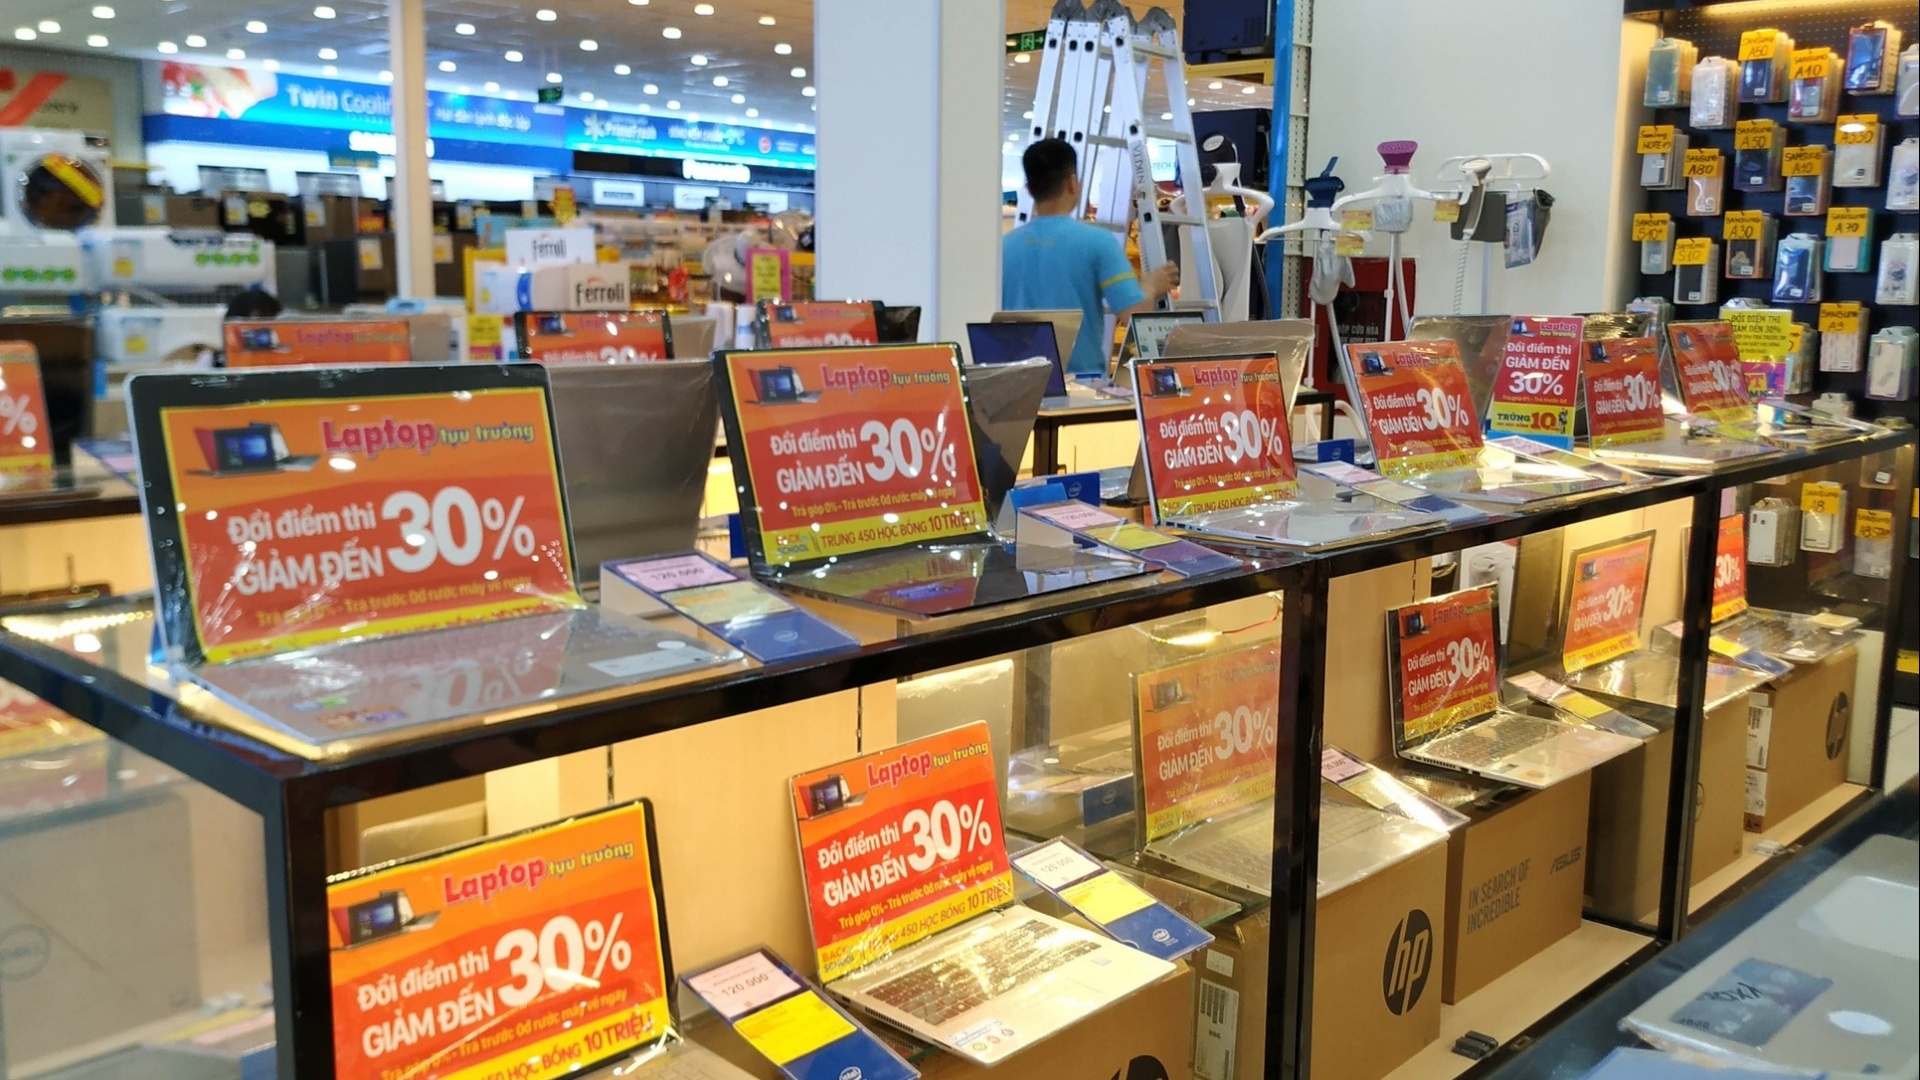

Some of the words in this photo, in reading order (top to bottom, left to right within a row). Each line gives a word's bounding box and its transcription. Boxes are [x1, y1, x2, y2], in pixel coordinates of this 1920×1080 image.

[1749, 45, 1768, 57] A50
[1795, 65, 1822, 79] A10
[287, 84, 338, 110] Twin
[1685, 154, 1718, 162] SAMSUNG
[1688, 164, 1714, 176] A80
[1785, 152, 1822, 162] SAMSUNG
[1635, 219, 1668, 227] SAMSUNG
[1726, 217, 1761, 225] SAMSUNG
[1728, 225, 1754, 239] A30
[532, 239, 567, 261] Ferroli
[1678, 250, 1701, 261] S10
[575, 284, 624, 305] Ferroli
[1540, 321, 1577, 332] Laptop
[1820, 309, 1860, 318] SAMSUNG
[1506, 354, 1540, 369] GIẢM
[1541, 355, 1570, 370] ĐẾN
[1507, 341, 1525, 352] Đổi
[1527, 342, 1554, 353] điểm
[1556, 344, 1571, 355] thi
[821, 363, 890, 392] Laptop
[1192, 365, 1239, 391] Laptop
[1509, 371, 1564, 395] 30%
[1373, 394, 1386, 410] Đổi
[1387, 392, 1406, 408] điểm
[1405, 393, 1417, 407] thi
[1624, 374, 1660, 412] 30%
[1379, 413, 1404, 435] GIẢM
[1403, 410, 1423, 432] ĐẾN
[1416, 387, 1469, 430] 30%
[1497, 411, 1530, 421] TRÚNG
[1530, 411, 1557, 430] 10
[320, 417, 438, 459] Laptop
[770, 429, 797, 456] Đổi
[799, 428, 836, 453] điểm
[838, 427, 857, 449] thi
[1159, 416, 1178, 439] Đổi
[1179, 414, 1203, 436] điểm
[1204, 415, 1219, 434] thi
[1220, 409, 1283, 460] 30%
[860, 417, 956, 482] 30%
[1164, 440, 1196, 470] GIẢM
[1196, 436, 1223, 466] ĐẾN
[776, 460, 825, 494] GIẢM
[825, 454, 865, 488] ĐẾN
[842, 498, 856, 510] Trả
[1217, 498, 1230, 510] 450
[227, 510, 271, 545] Đổi
[275, 505, 341, 540] điểm
[341, 502, 376, 531] thi
[382, 485, 536, 574] 30%
[821, 530, 855, 548] TRÚNG
[858, 529, 876, 543] 450
[876, 525, 899, 542] HỌC
[900, 519, 928, 536] BỔNG
[928, 517, 942, 532] 10
[234, 547, 317, 597] GIẢM
[319, 539, 384, 585] ĐẾN
[1715, 554, 1741, 588] 30%
[1433, 604, 1464, 623] Laptop
[1606, 584, 1636, 622] 30%
[1407, 653, 1419, 672] Đổi
[1419, 649, 1436, 667] điểm
[1436, 647, 1446, 662] thi
[1446, 637, 1490, 682] 30%
[1408, 672, 1429, 697] GIẢM
[1430, 666, 1448, 689] ĐẾN
[1157, 733, 1173, 751] Đổi
[1174, 723, 1198, 745] điểm
[1199, 720, 1212, 738] thi
[1213, 704, 1274, 760] 30%
[867, 750, 932, 791] Laptop
[1159, 752, 1190, 781] GIẢM
[1190, 743, 1213, 772] ĐẾN
[818, 841, 844, 871] Đổi
[845, 829, 878, 862] điểm
[879, 821, 900, 850] thi
[902, 797, 993, 873] 30%
[442, 856, 546, 905] Laptop
[580, 841, 634, 868] trường
[1040, 857, 1074, 873] 120.000
[1551, 846, 1581, 875] ASUS
[823, 866, 871, 909] GIẢM
[870, 850, 908, 895] ĐẾN
[1468, 888, 1480, 910] IN
[1481, 868, 1517, 905] SEARCH
[1518, 858, 1531, 881] OF
[839, 914, 854, 930] Trả
[855, 910, 872, 928] góp
[872, 903, 885, 917] 0%
[887, 894, 901, 910] Trả
[901, 887, 924, 905] trước
[924, 882, 934, 895] 0đ
[977, 860, 994, 876] ngay
[901, 924, 918, 938] 450
[919, 916, 939, 934] HỌC
[940, 903, 966, 922] BỔNG
[967, 895, 979, 909] 10
[1467, 886, 1521, 935] INCREDIBLE
[493, 911, 632, 1009] 30%
[822, 945, 847, 962] BACK
[1384, 909, 1432, 1015] hp
[356, 974, 398, 1013] Đổi
[401, 957, 458, 999] điểm
[460, 945, 490, 980] thi
[721, 972, 769, 996] 120.000
[362, 1010, 436, 1059] GIẢM
[437, 979, 495, 1035] ĐẾN
[516, 1020, 533, 1036] 0đ
[600, 989, 628, 1009] ngay
[541, 1038, 582, 1070] BỔNG
[583, 1031, 604, 1051] 10
